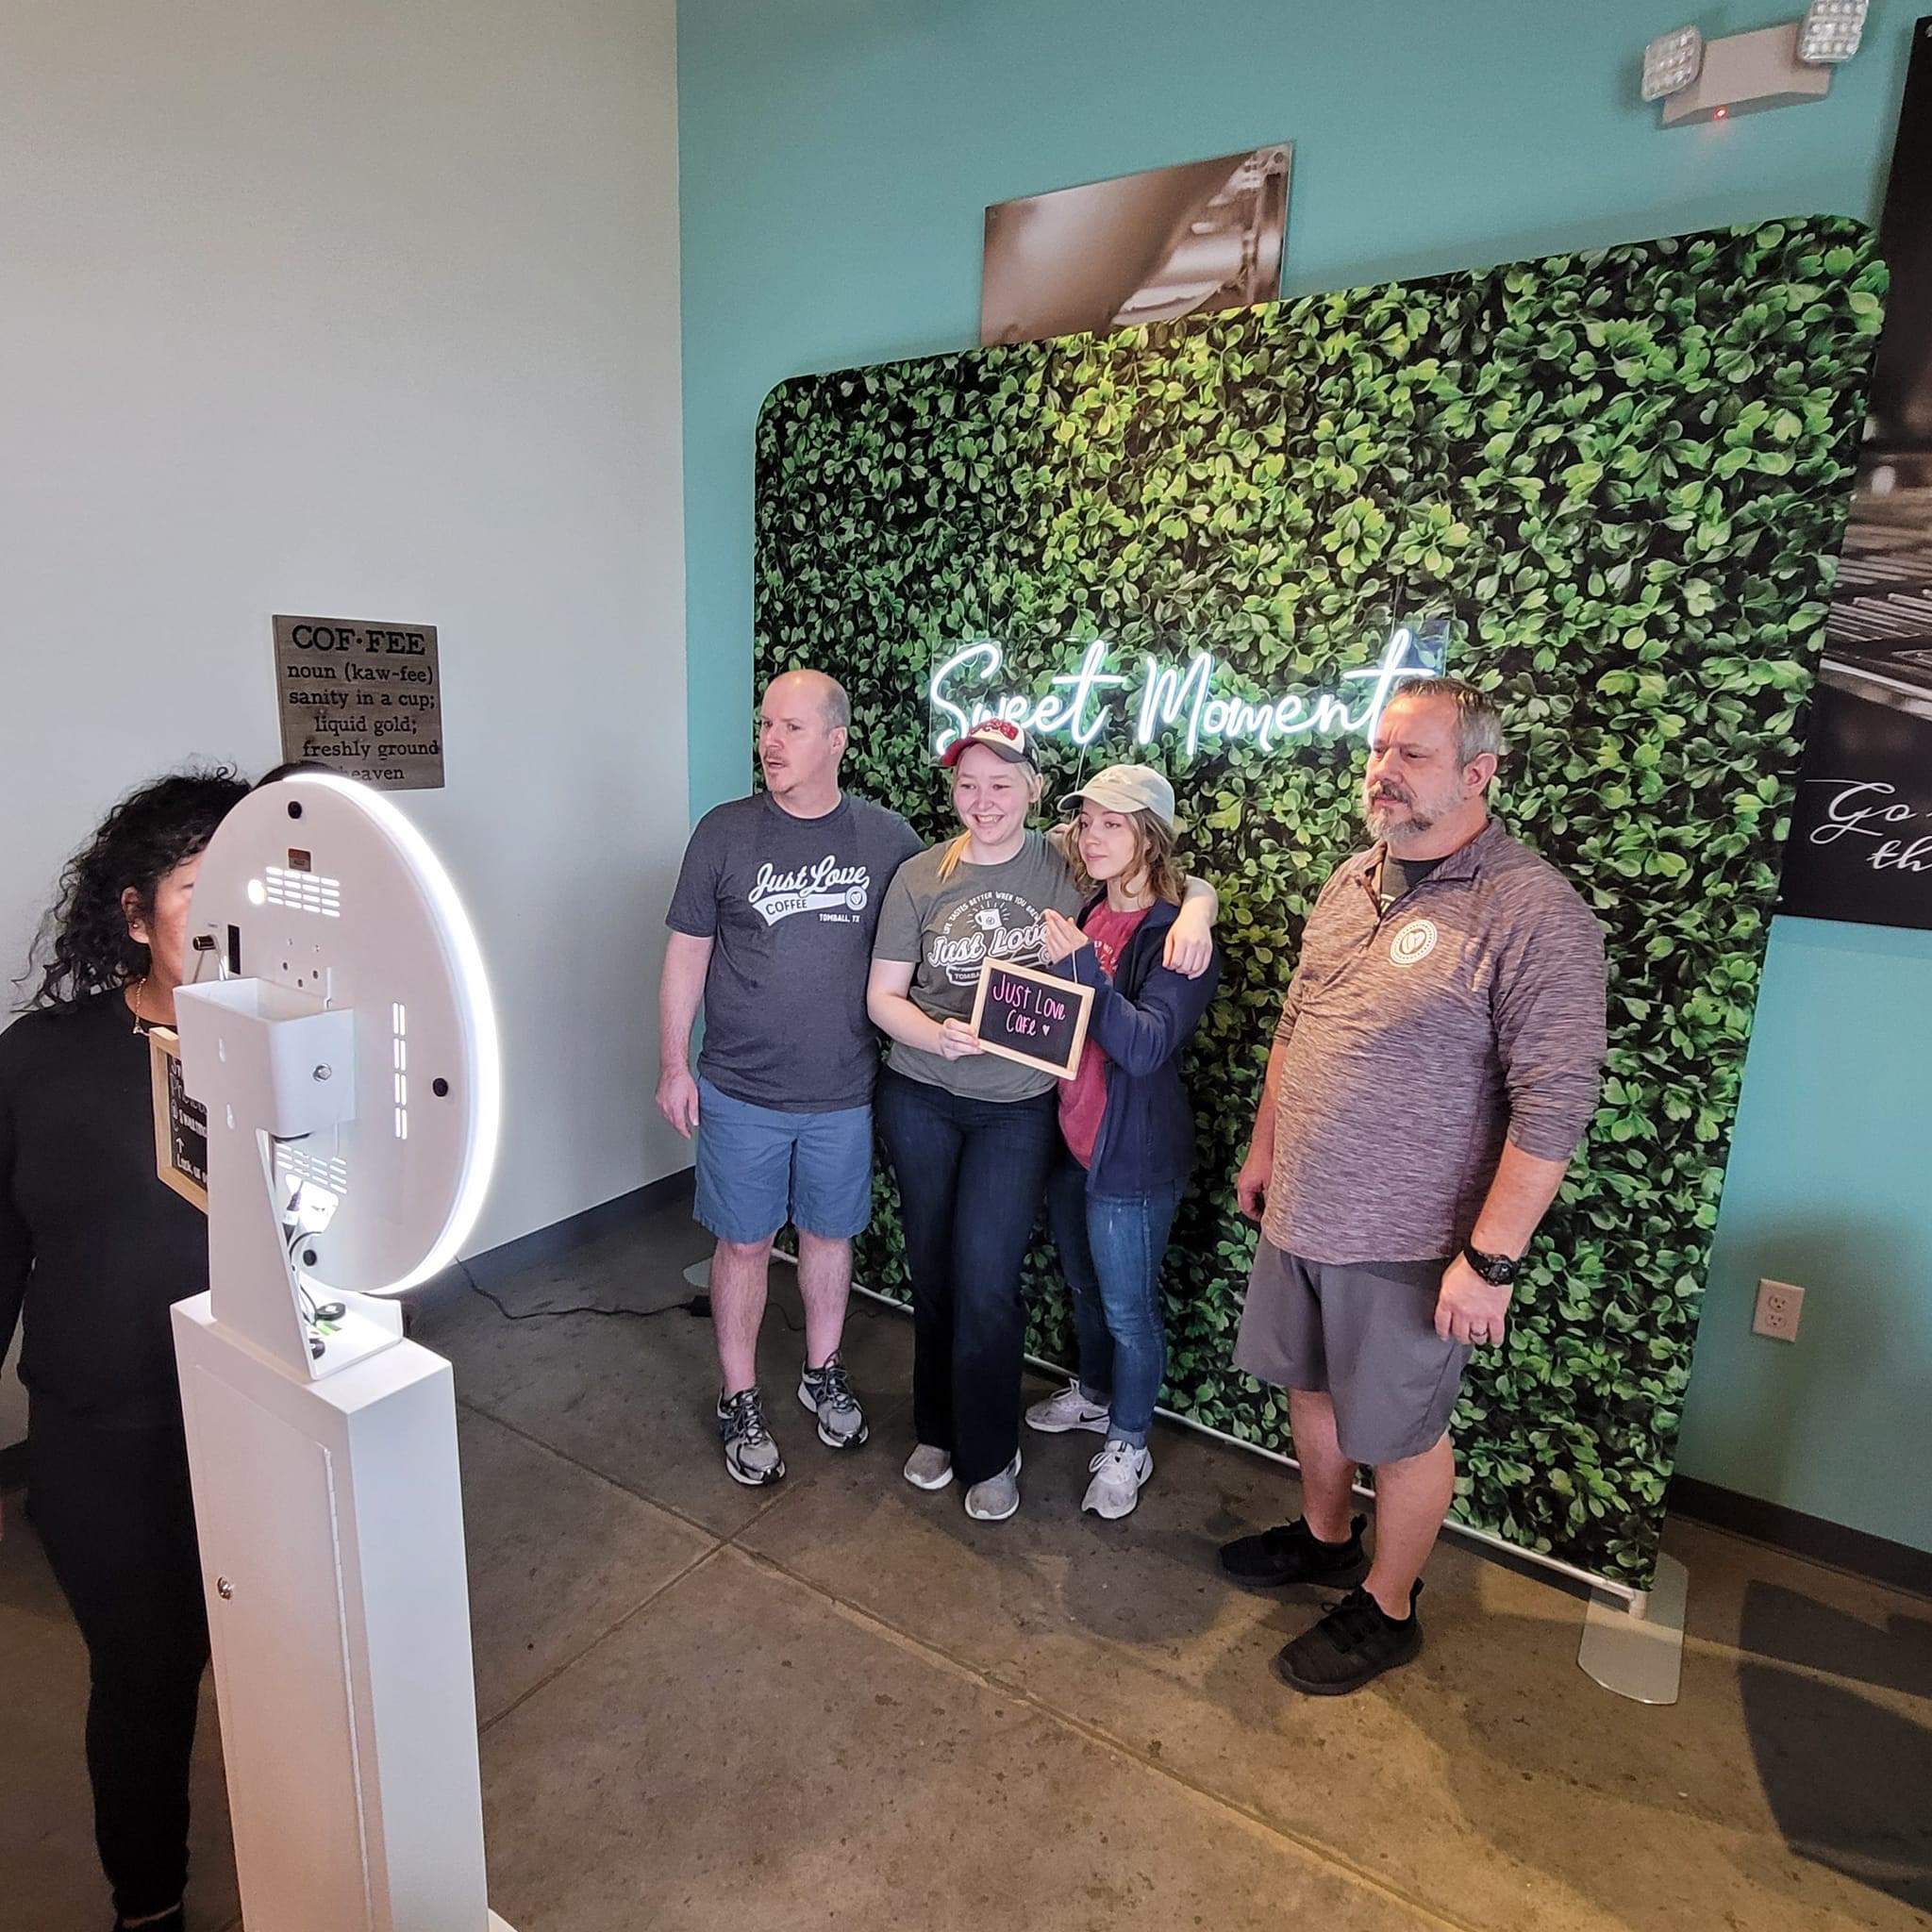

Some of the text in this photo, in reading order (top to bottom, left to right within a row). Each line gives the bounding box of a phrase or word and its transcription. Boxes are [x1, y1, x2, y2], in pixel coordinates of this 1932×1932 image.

[287, 662, 433, 685] noun (kaw-fee)
[289, 689, 436, 711] sanity in a cup;
[930, 642, 1124, 756] Sweet
[314, 716, 417, 737] liquid gold;
[302, 740, 441, 760] freshly ground
[340, 765, 405, 781] eaven
[1805, 779, 1917, 844] Go
[748, 855, 871, 903] Just Love
[765, 899, 808, 915] COFFEE
[928, 932, 987, 967] Just
